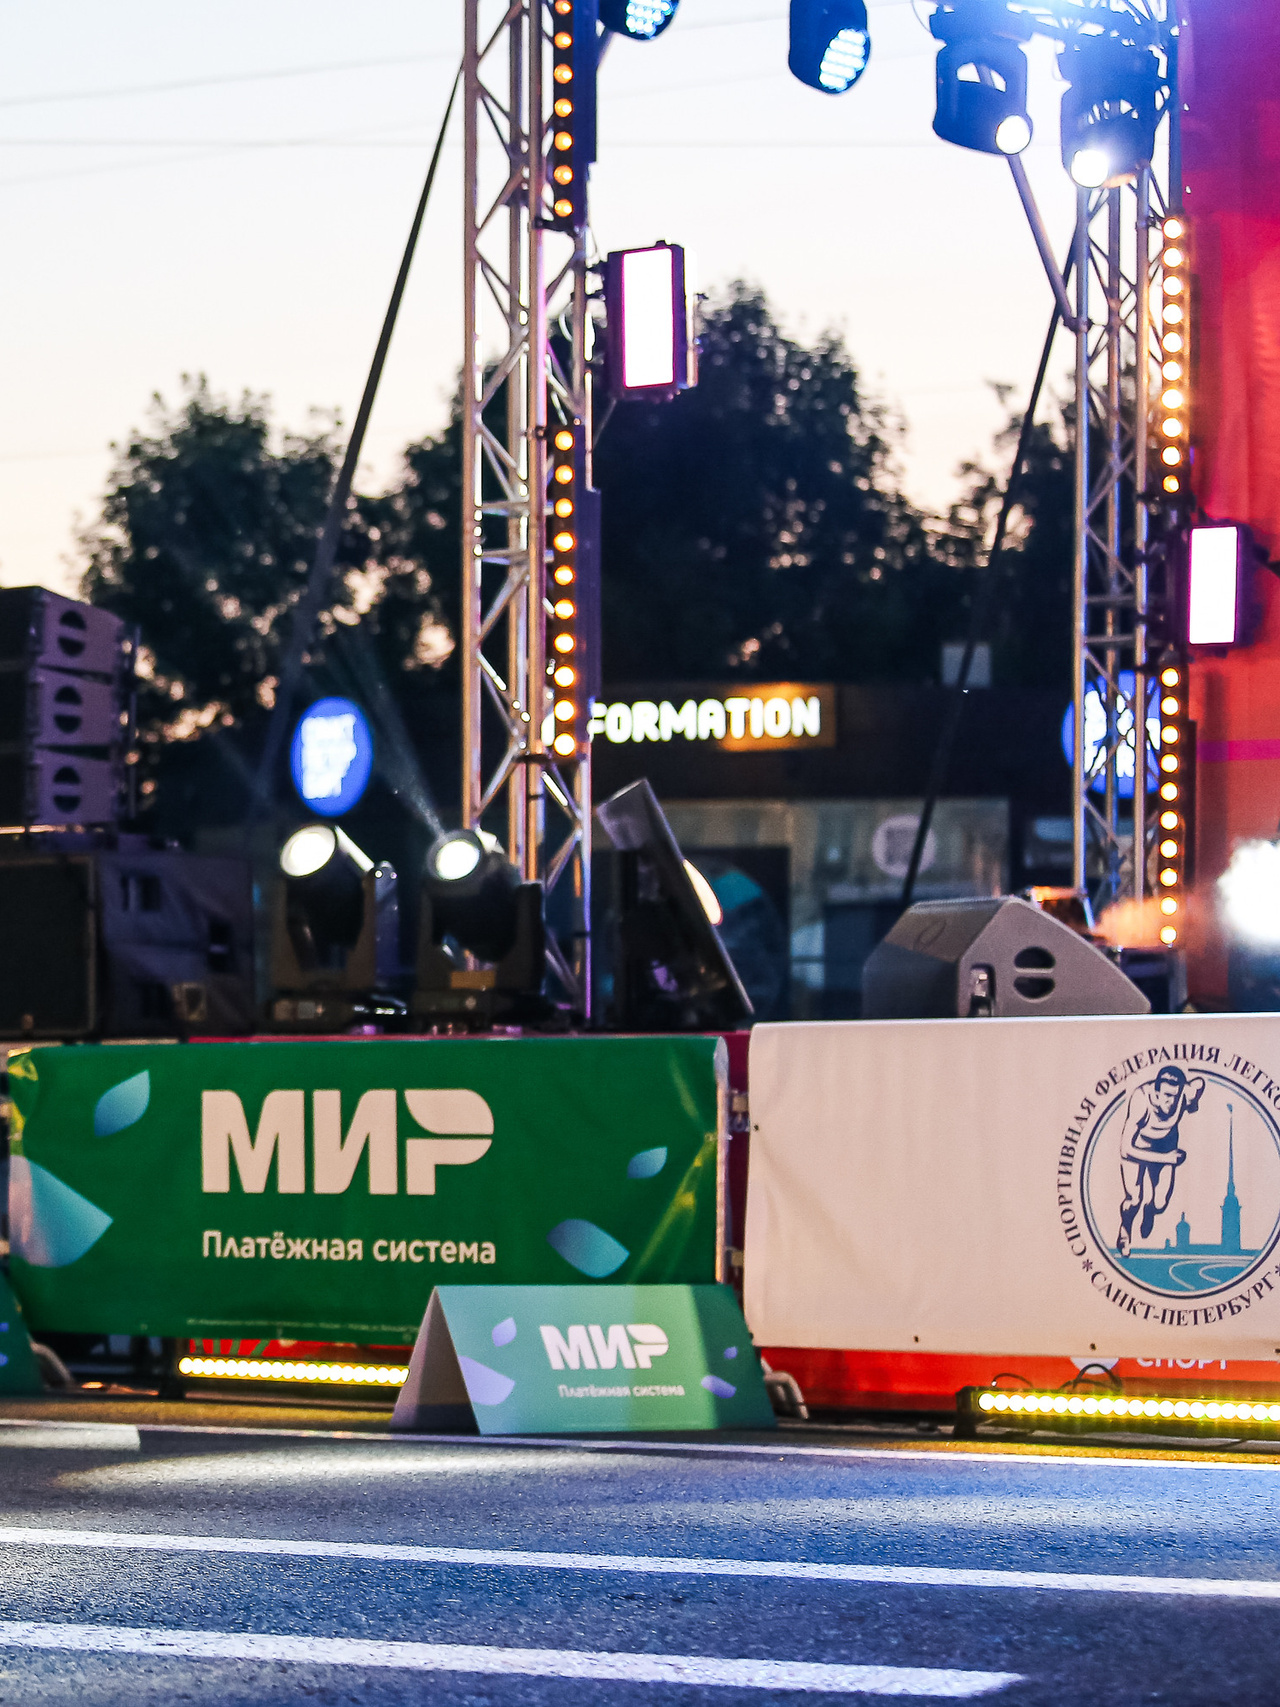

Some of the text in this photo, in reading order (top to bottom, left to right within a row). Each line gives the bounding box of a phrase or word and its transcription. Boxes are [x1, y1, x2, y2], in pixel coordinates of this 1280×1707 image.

[201, 1088, 495, 1196] МИР
[1057, 1097, 1098, 1257] СПОРТИВНАЯ
[1095, 1043, 1221, 1097] ФЕДЕРАЦИЯ
[202, 1229, 497, 1265] Платёжная система
[1091, 1269, 1274, 1328] САНКТ-ПЕТЕРБУРГ
[539, 1323, 669, 1371] МИР
